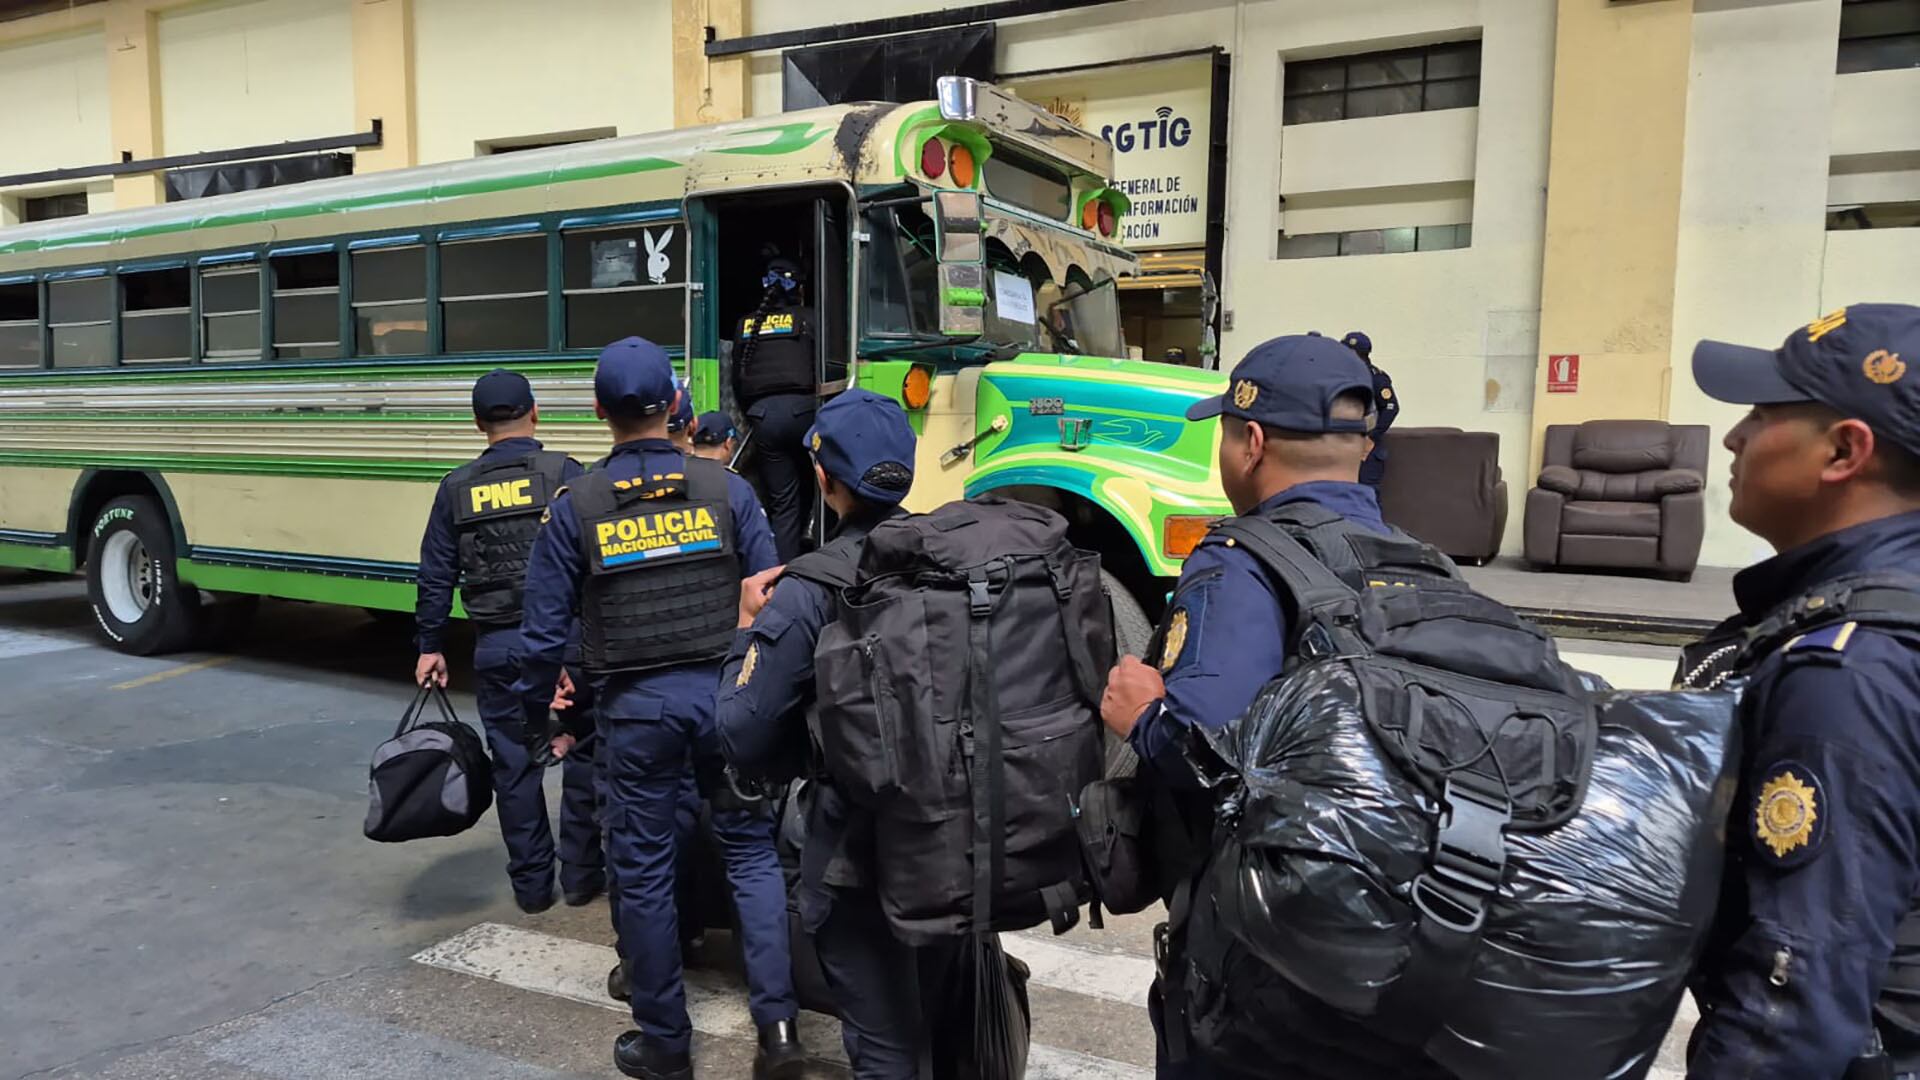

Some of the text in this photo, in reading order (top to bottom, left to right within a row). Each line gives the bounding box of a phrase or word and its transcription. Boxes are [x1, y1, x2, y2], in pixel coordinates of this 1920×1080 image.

[1166, 176, 1181, 192] DE
[1122, 194, 1198, 217] NFORMACIÓN
[744, 314, 793, 329] PICIA
[471, 479, 533, 513] PNC
[94, 507, 135, 538] FORTUNE
[597, 508, 715, 545] POLICIA
[601, 528, 718, 557] NACIONAL CIVIL
